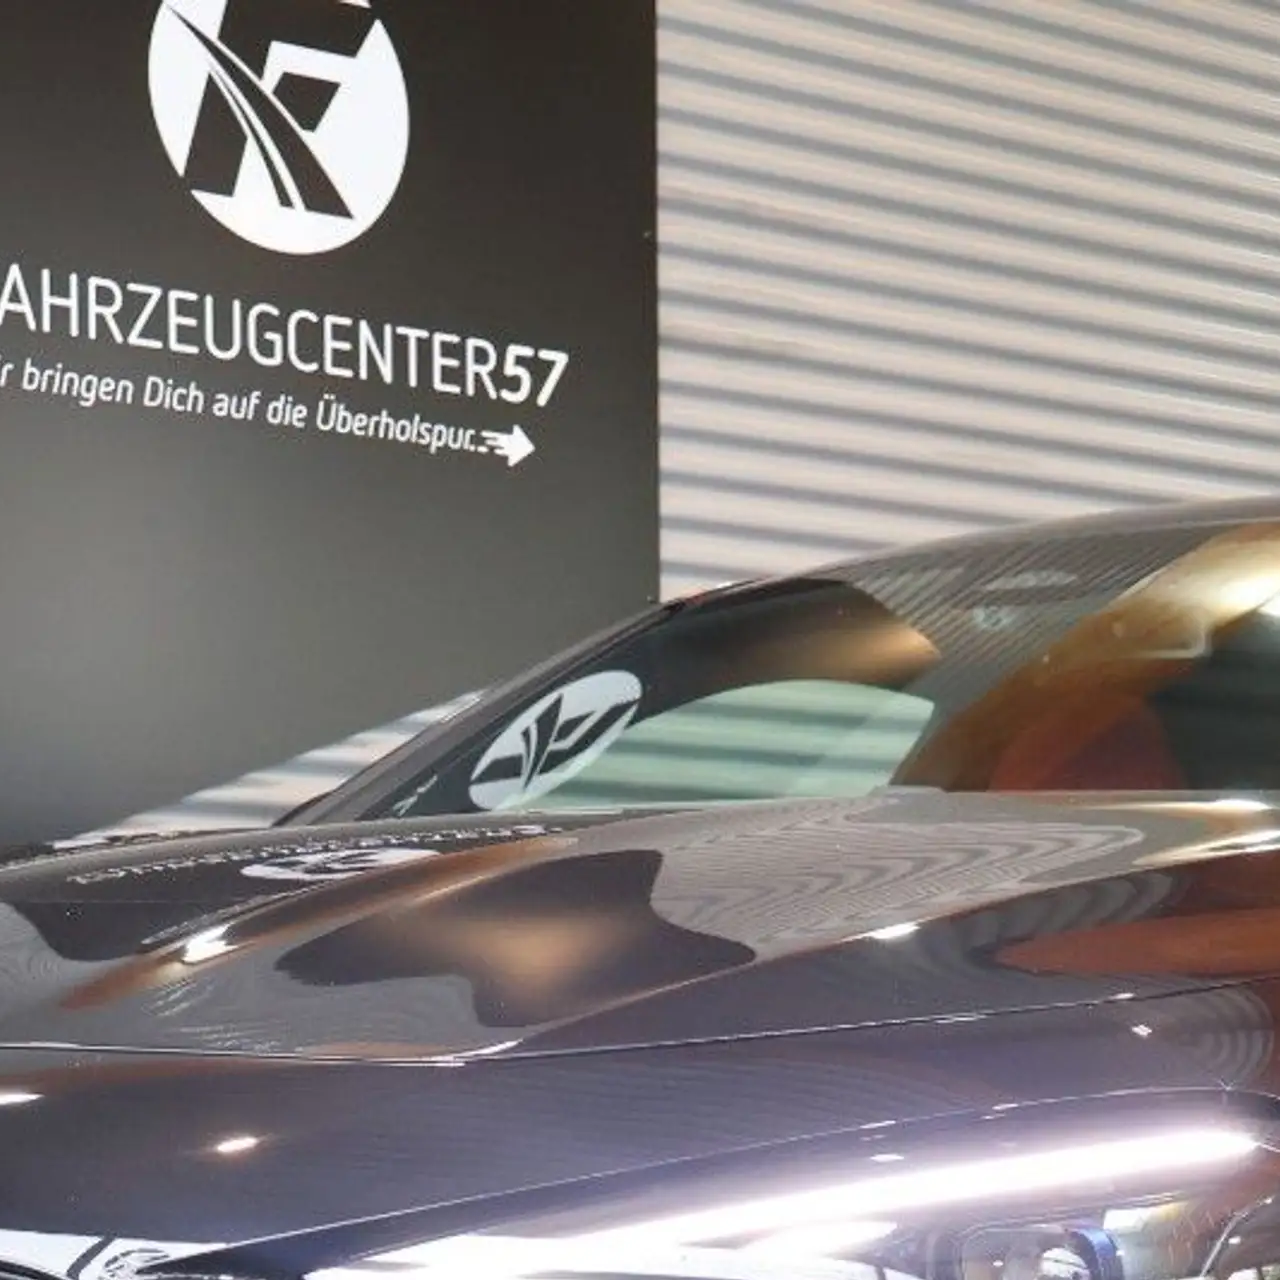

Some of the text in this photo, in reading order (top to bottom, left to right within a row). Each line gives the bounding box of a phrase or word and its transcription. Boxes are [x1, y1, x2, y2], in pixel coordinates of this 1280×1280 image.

[21, 357, 135, 408] bringen
[142, 375, 205, 415] Dich
[211, 389, 262, 421] auf
[265, 393, 309, 428] die
